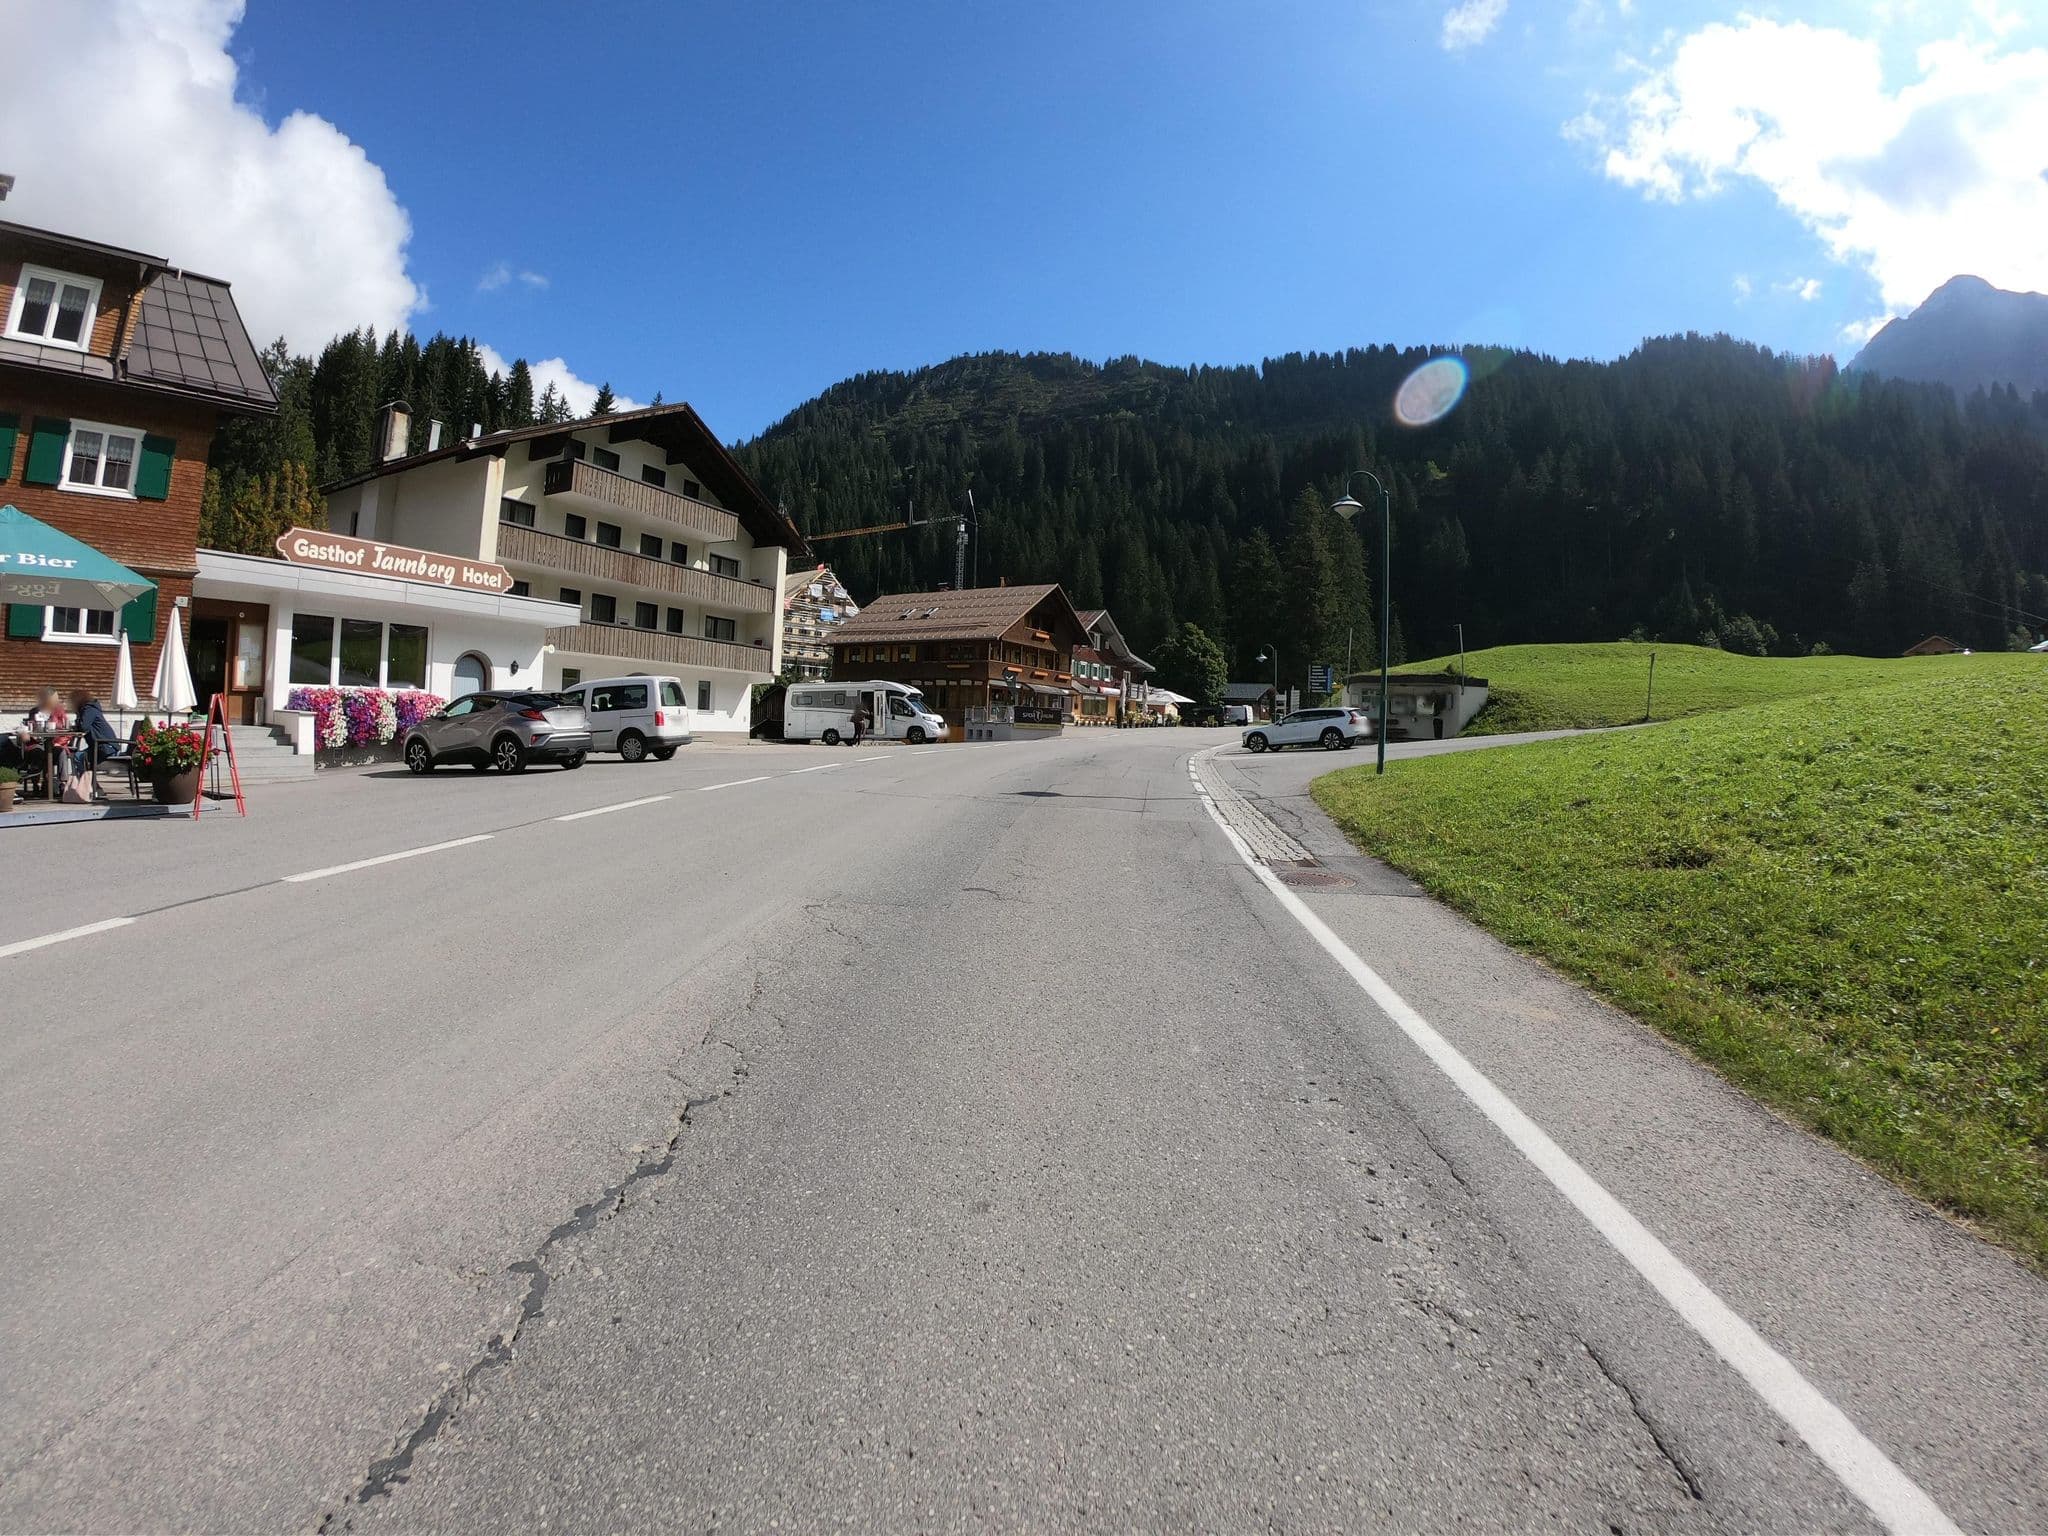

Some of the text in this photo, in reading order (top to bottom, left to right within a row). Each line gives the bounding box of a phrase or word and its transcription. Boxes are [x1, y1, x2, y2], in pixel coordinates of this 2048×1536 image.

[17, 553, 78, 569] Bier
[293, 538, 503, 588] Gasthof Tannberg Hotel
